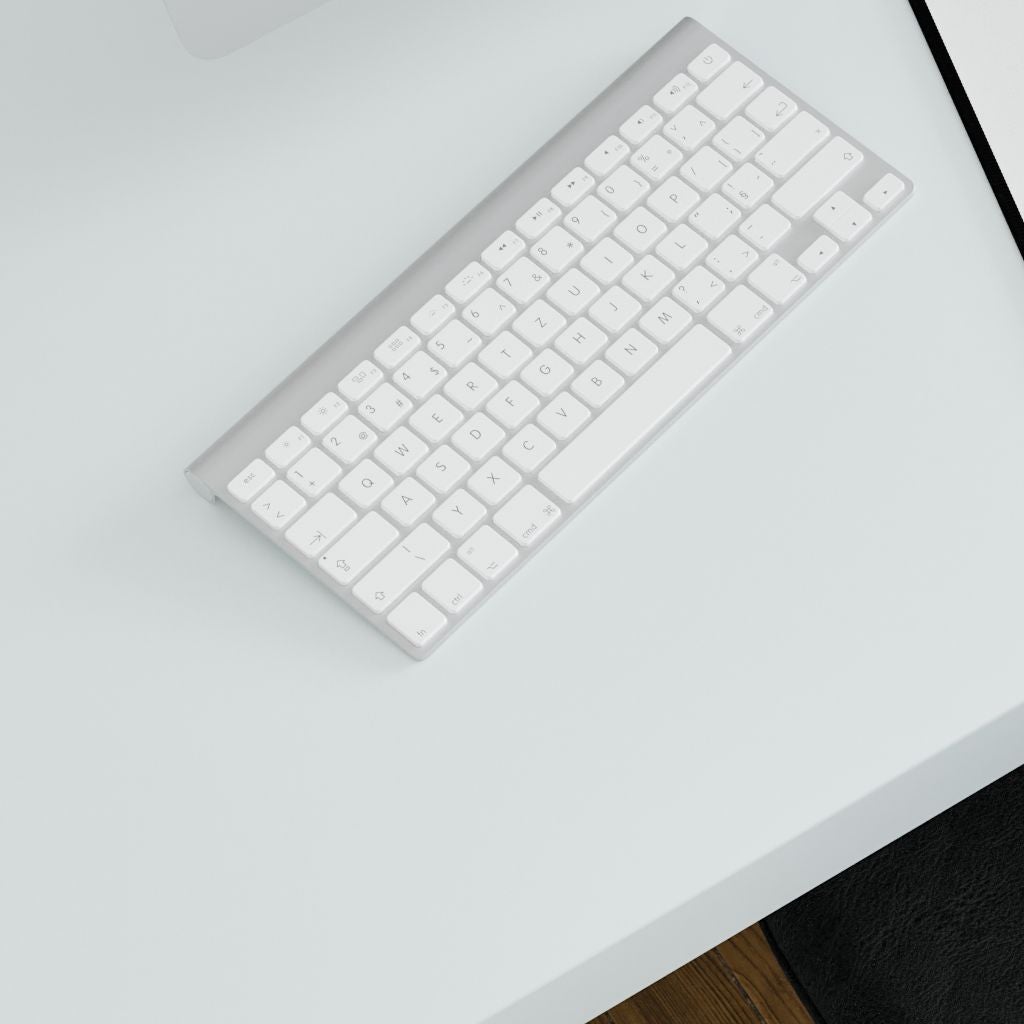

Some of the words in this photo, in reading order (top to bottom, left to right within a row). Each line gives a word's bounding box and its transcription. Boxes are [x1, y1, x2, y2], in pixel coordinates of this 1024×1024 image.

[668, 192, 679, 205] P
[570, 215, 581, 225] 9
[635, 223, 649, 235] O
[536, 246, 549, 257] 8
[674, 240, 687, 251] L
[639, 270, 653, 281] K
[502, 277, 513, 288] 7
[567, 284, 582, 297] U
[608, 301, 619, 312] J
[469, 309, 481, 319] 6
[656, 311, 673, 326] M
[534, 316, 548, 329] Z
[571, 331, 587, 345] H
[434, 340, 447, 351] 5
[623, 343, 639, 356] N
[499, 348, 512, 359] T
[538, 363, 552, 376] G
[401, 371, 412, 382] 4
[590, 375, 603, 388] B
[465, 380, 479, 392] R
[504, 395, 515, 408] F
[364, 404, 377, 415] 3
[555, 407, 568, 418] V
[430, 412, 444, 424] E
[468, 428, 483, 441] D
[329, 436, 342, 447] 2
[522, 440, 535, 451] C
[392, 442, 410, 458] W
[434, 461, 448, 473] S
[360, 477, 375, 489] Q
[486, 472, 501, 486] X
[400, 494, 414, 507] A
[450, 504, 463, 515] Y
